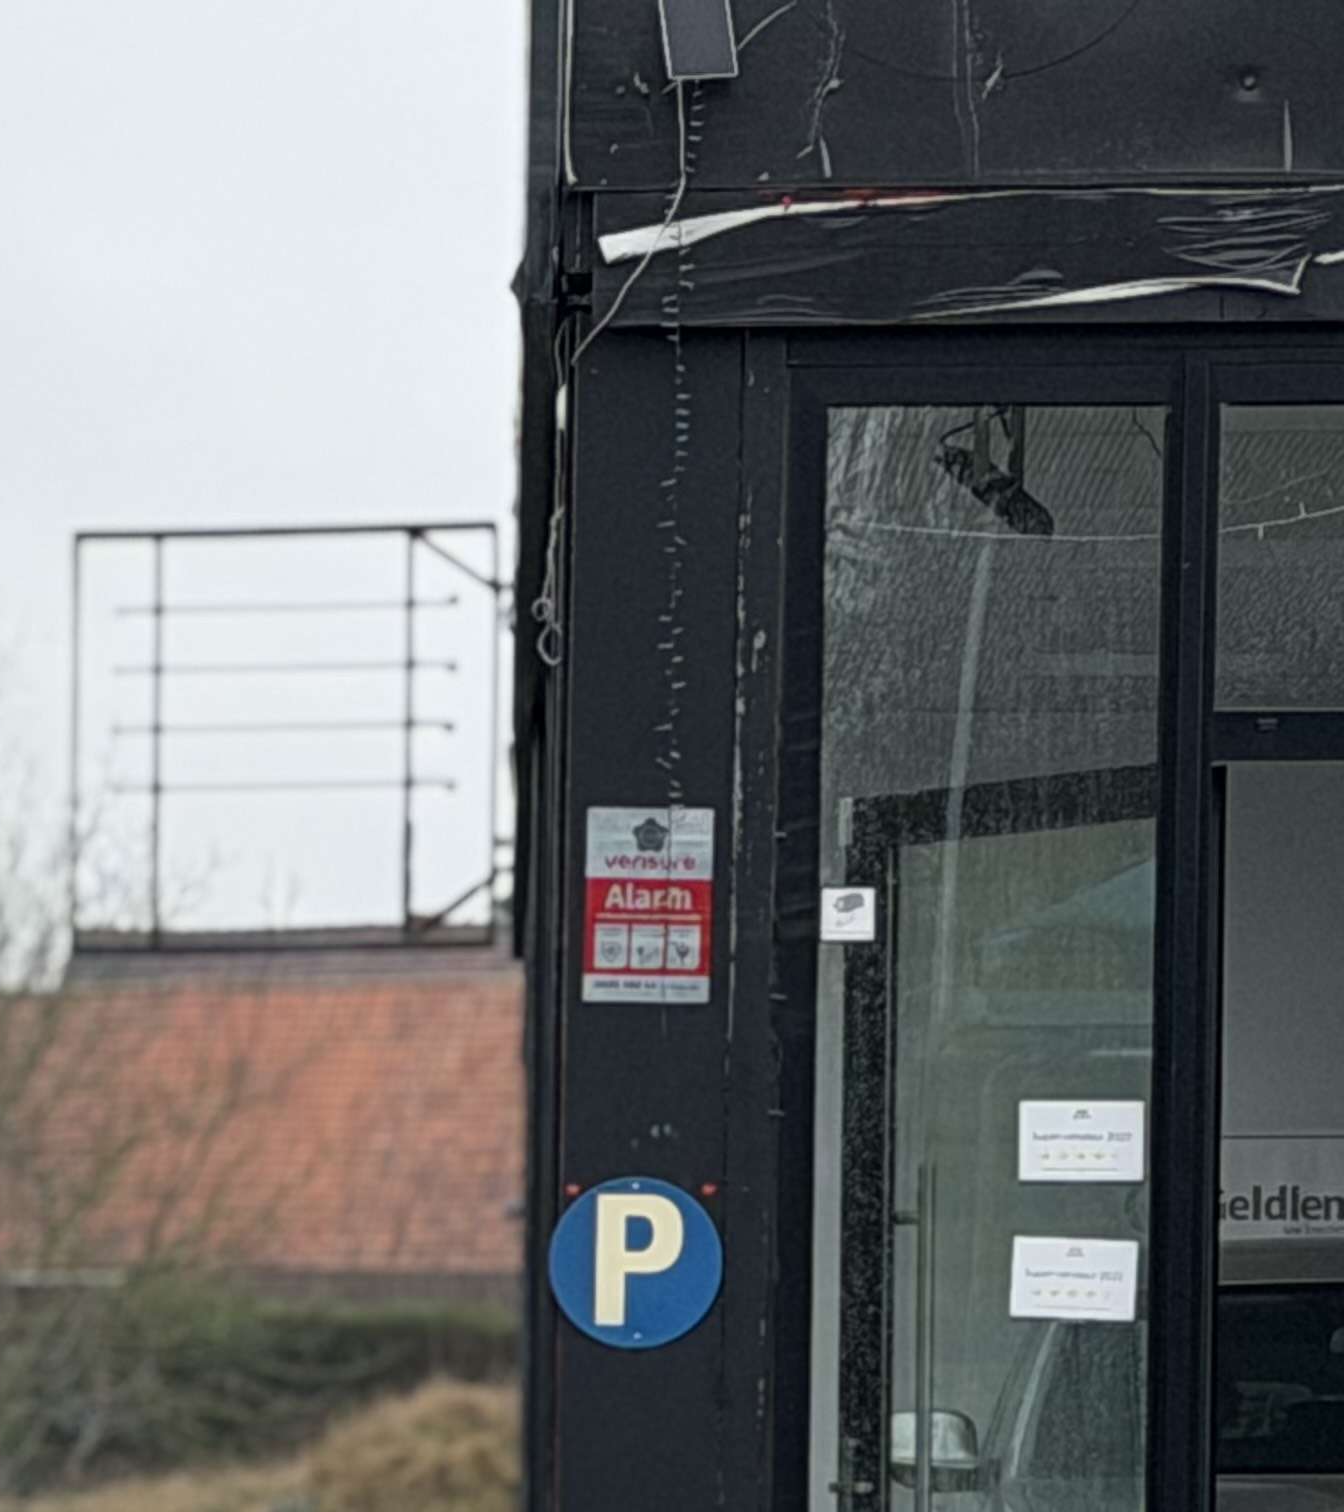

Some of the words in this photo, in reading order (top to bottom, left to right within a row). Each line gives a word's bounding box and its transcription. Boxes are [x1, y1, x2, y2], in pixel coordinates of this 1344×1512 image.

[605, 853, 696, 871] verisure
[604, 882, 692, 910] Alarm
[1220, 1184, 1344, 1221] eldlen
[594, 1193, 684, 1327] P
